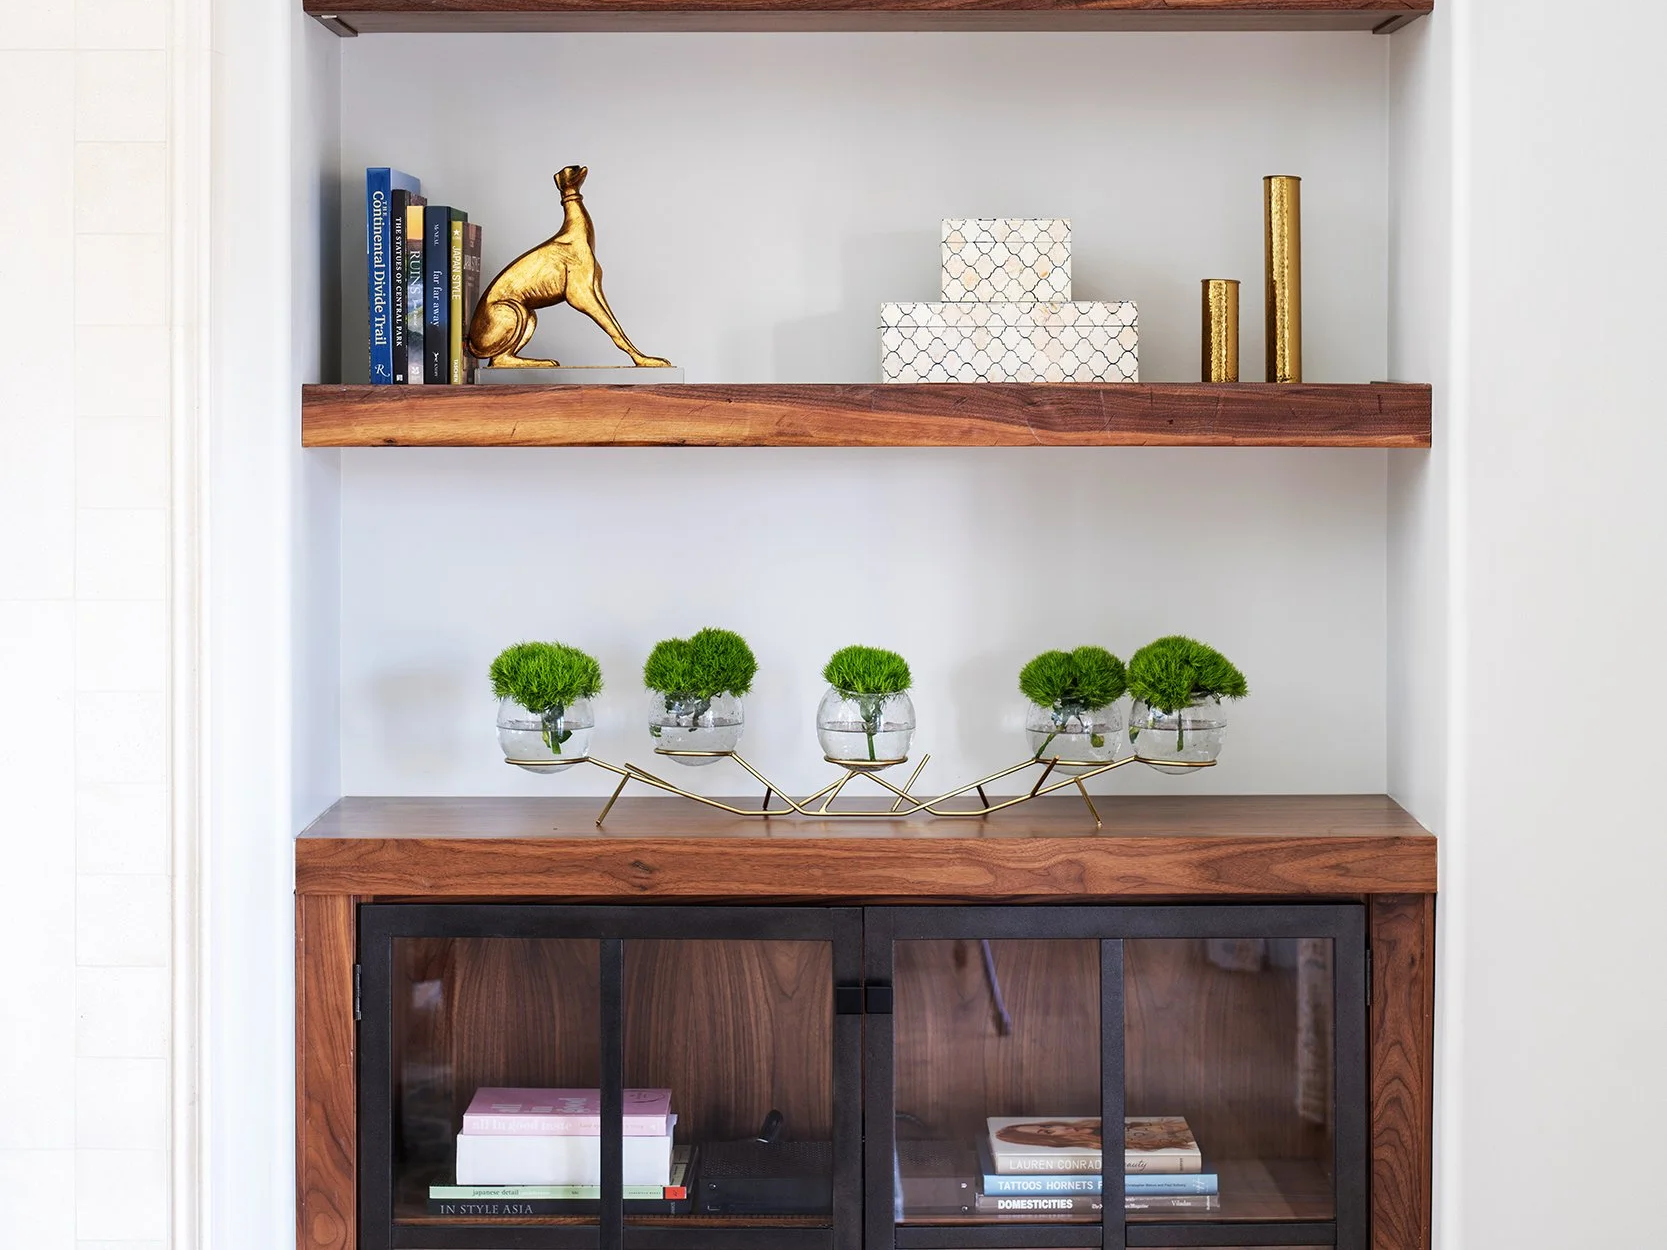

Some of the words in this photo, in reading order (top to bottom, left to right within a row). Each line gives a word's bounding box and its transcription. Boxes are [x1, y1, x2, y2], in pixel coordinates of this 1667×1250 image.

[372, 190, 387, 269] Continental
[452, 245, 462, 272] JAPAN
[395, 273, 402, 284] OF
[409, 250, 421, 295] RUINS
[433, 270, 443, 284] far
[373, 271, 387, 313] Divide
[433, 287, 443, 300] far
[452, 275, 461, 300] STYLE
[430, 302, 440, 327] away
[375, 314, 388, 346] Trail
[1009, 1160, 1054, 1170] LAUREN
[1057, 1160, 1102, 1170] CONRAD
[472, 1189, 499, 1197] japanese
[501, 1188, 519, 1196] detail
[998, 1181, 1042, 1191] TATTOOS
[1046, 1181, 1094, 1191] HORNETS
[440, 1204, 455, 1214] IN
[459, 1204, 499, 1214] STYLE
[502, 1204, 534, 1214] ASIA
[997, 1199, 1074, 1209] DOMESTICITIES
